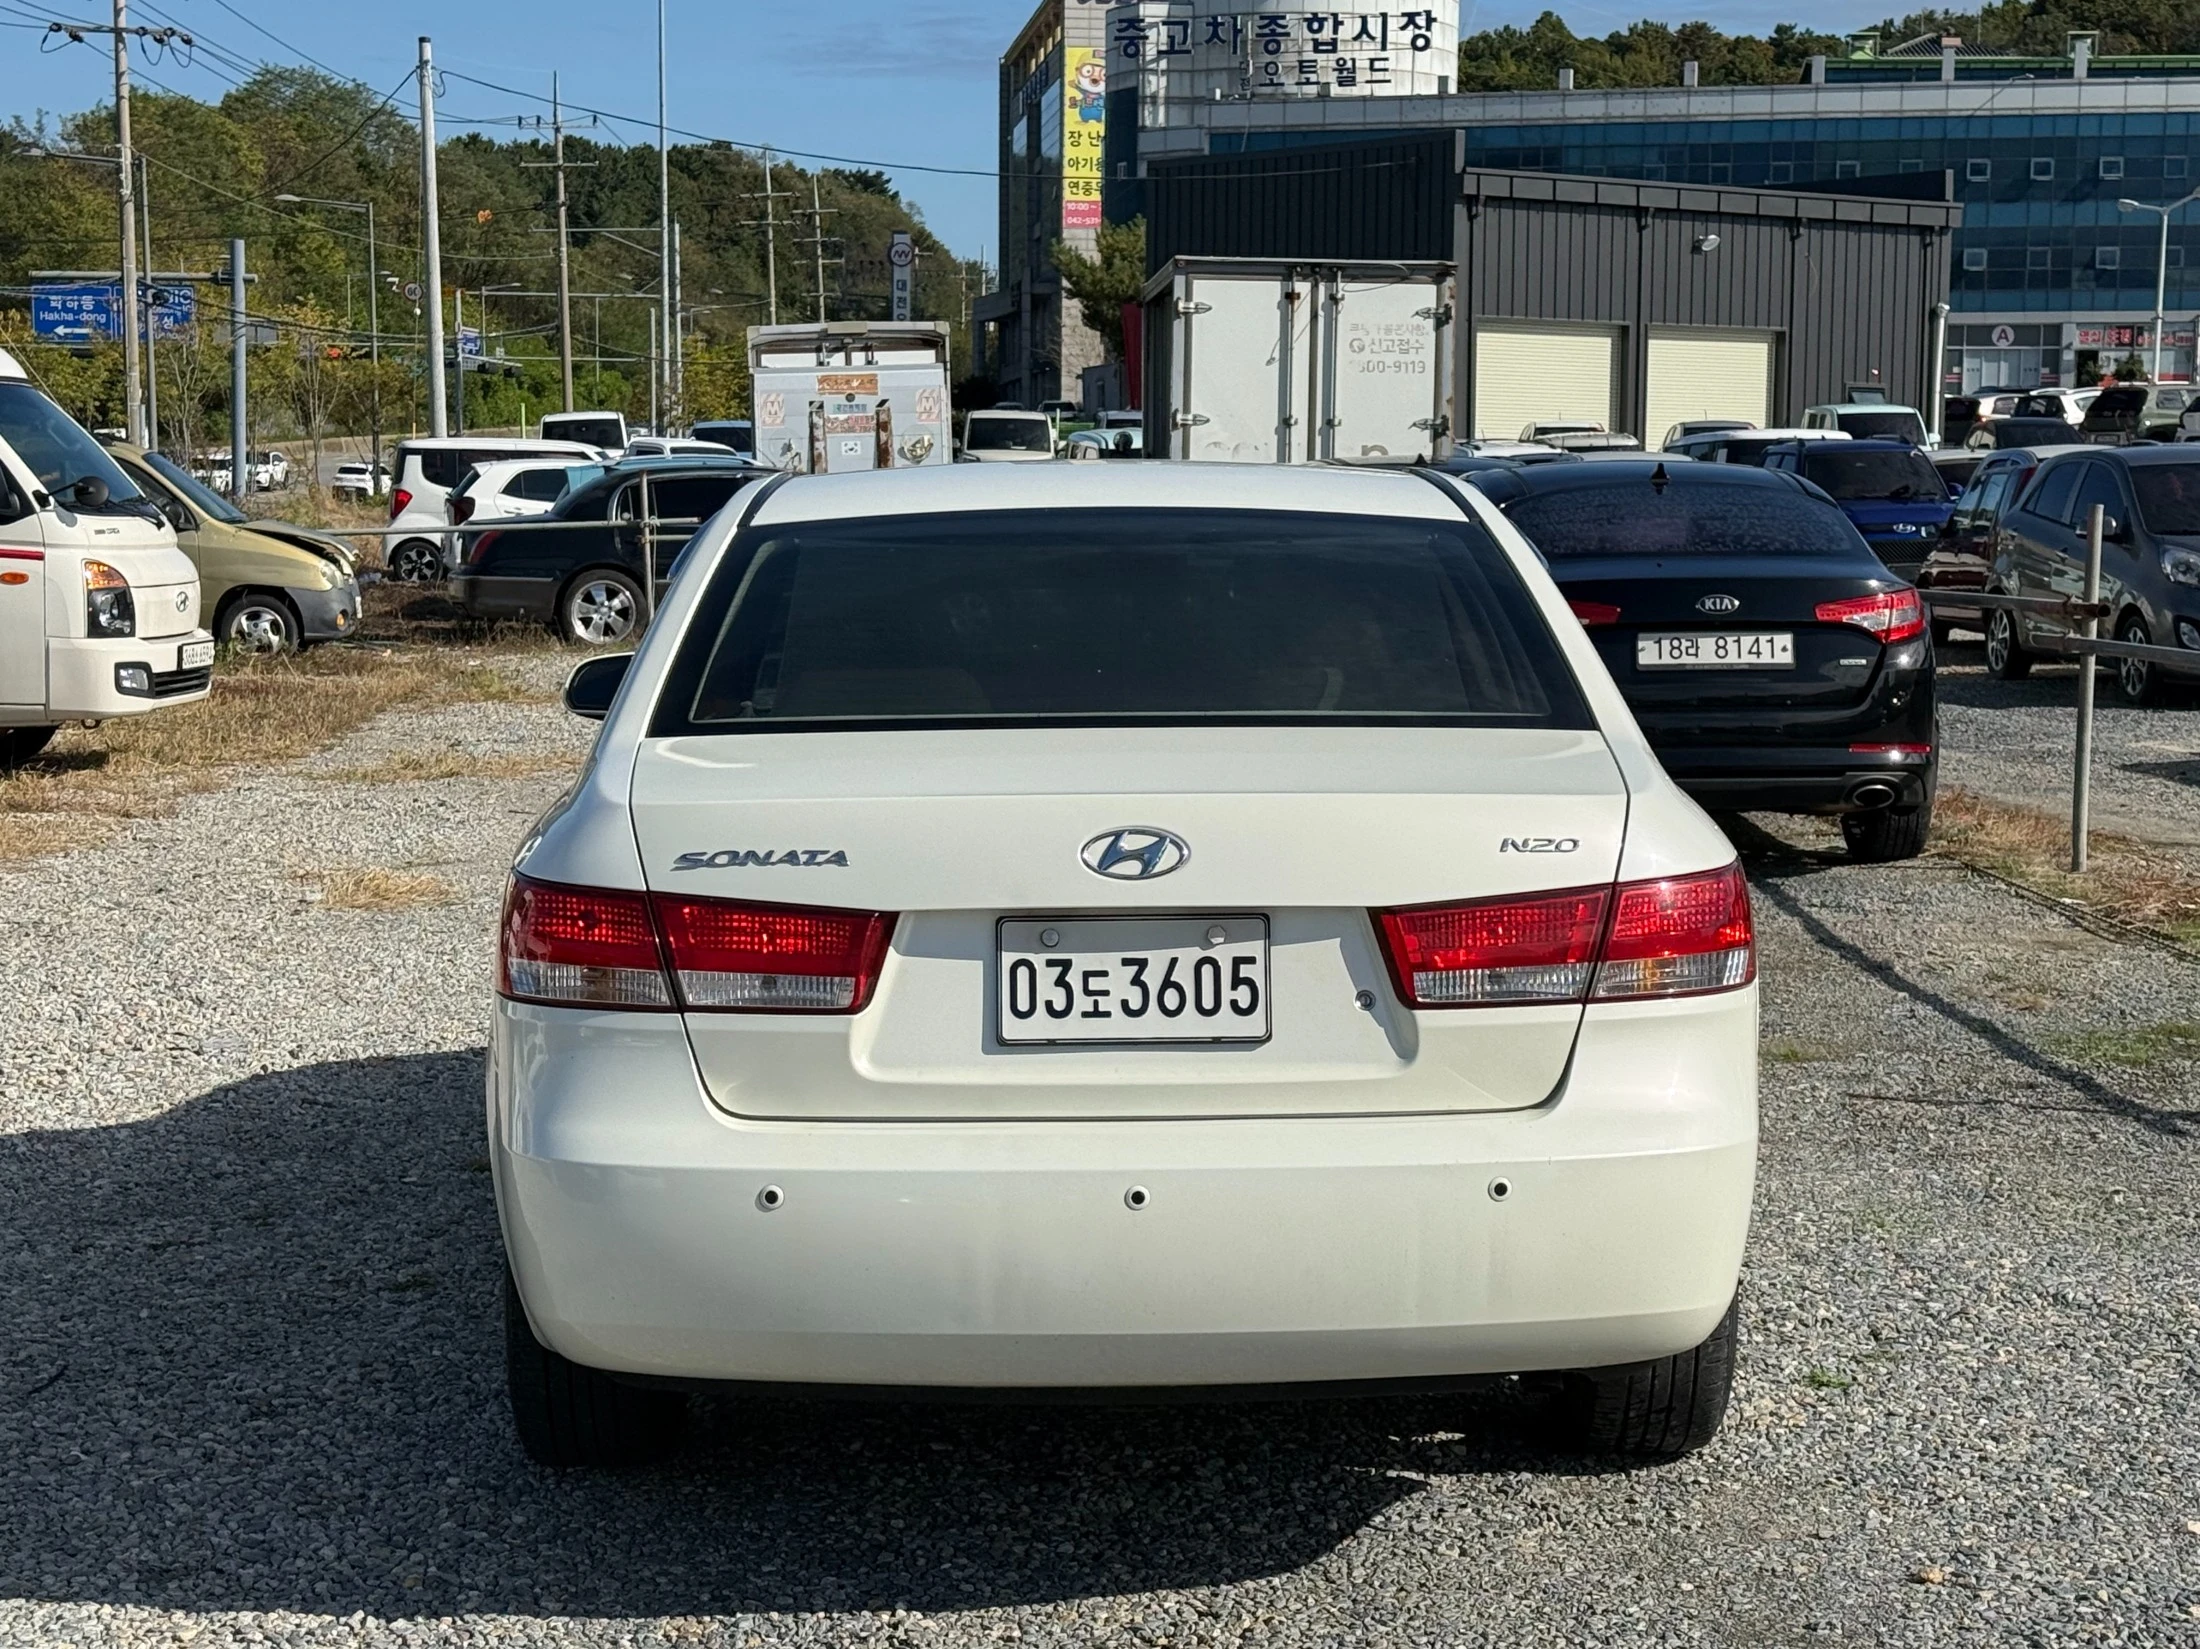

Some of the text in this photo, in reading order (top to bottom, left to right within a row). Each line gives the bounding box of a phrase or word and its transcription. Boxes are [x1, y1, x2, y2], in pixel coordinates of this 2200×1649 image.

[1114, 10, 1437, 59] 중고차종합시장
[1259, 56, 1392, 88] 오토월드
[40, 311, 106, 323] Hakha-dong
[1996, 328, 2008, 341] A
[1368, 338, 1425, 355] 신고접수
[1704, 598, 1733, 611] KIA
[1653, 635, 1777, 660] 18라 8141
[1499, 837, 1580, 853] N20
[669, 849, 850, 872] SONATA
[1009, 956, 1260, 1020] 03도3605
